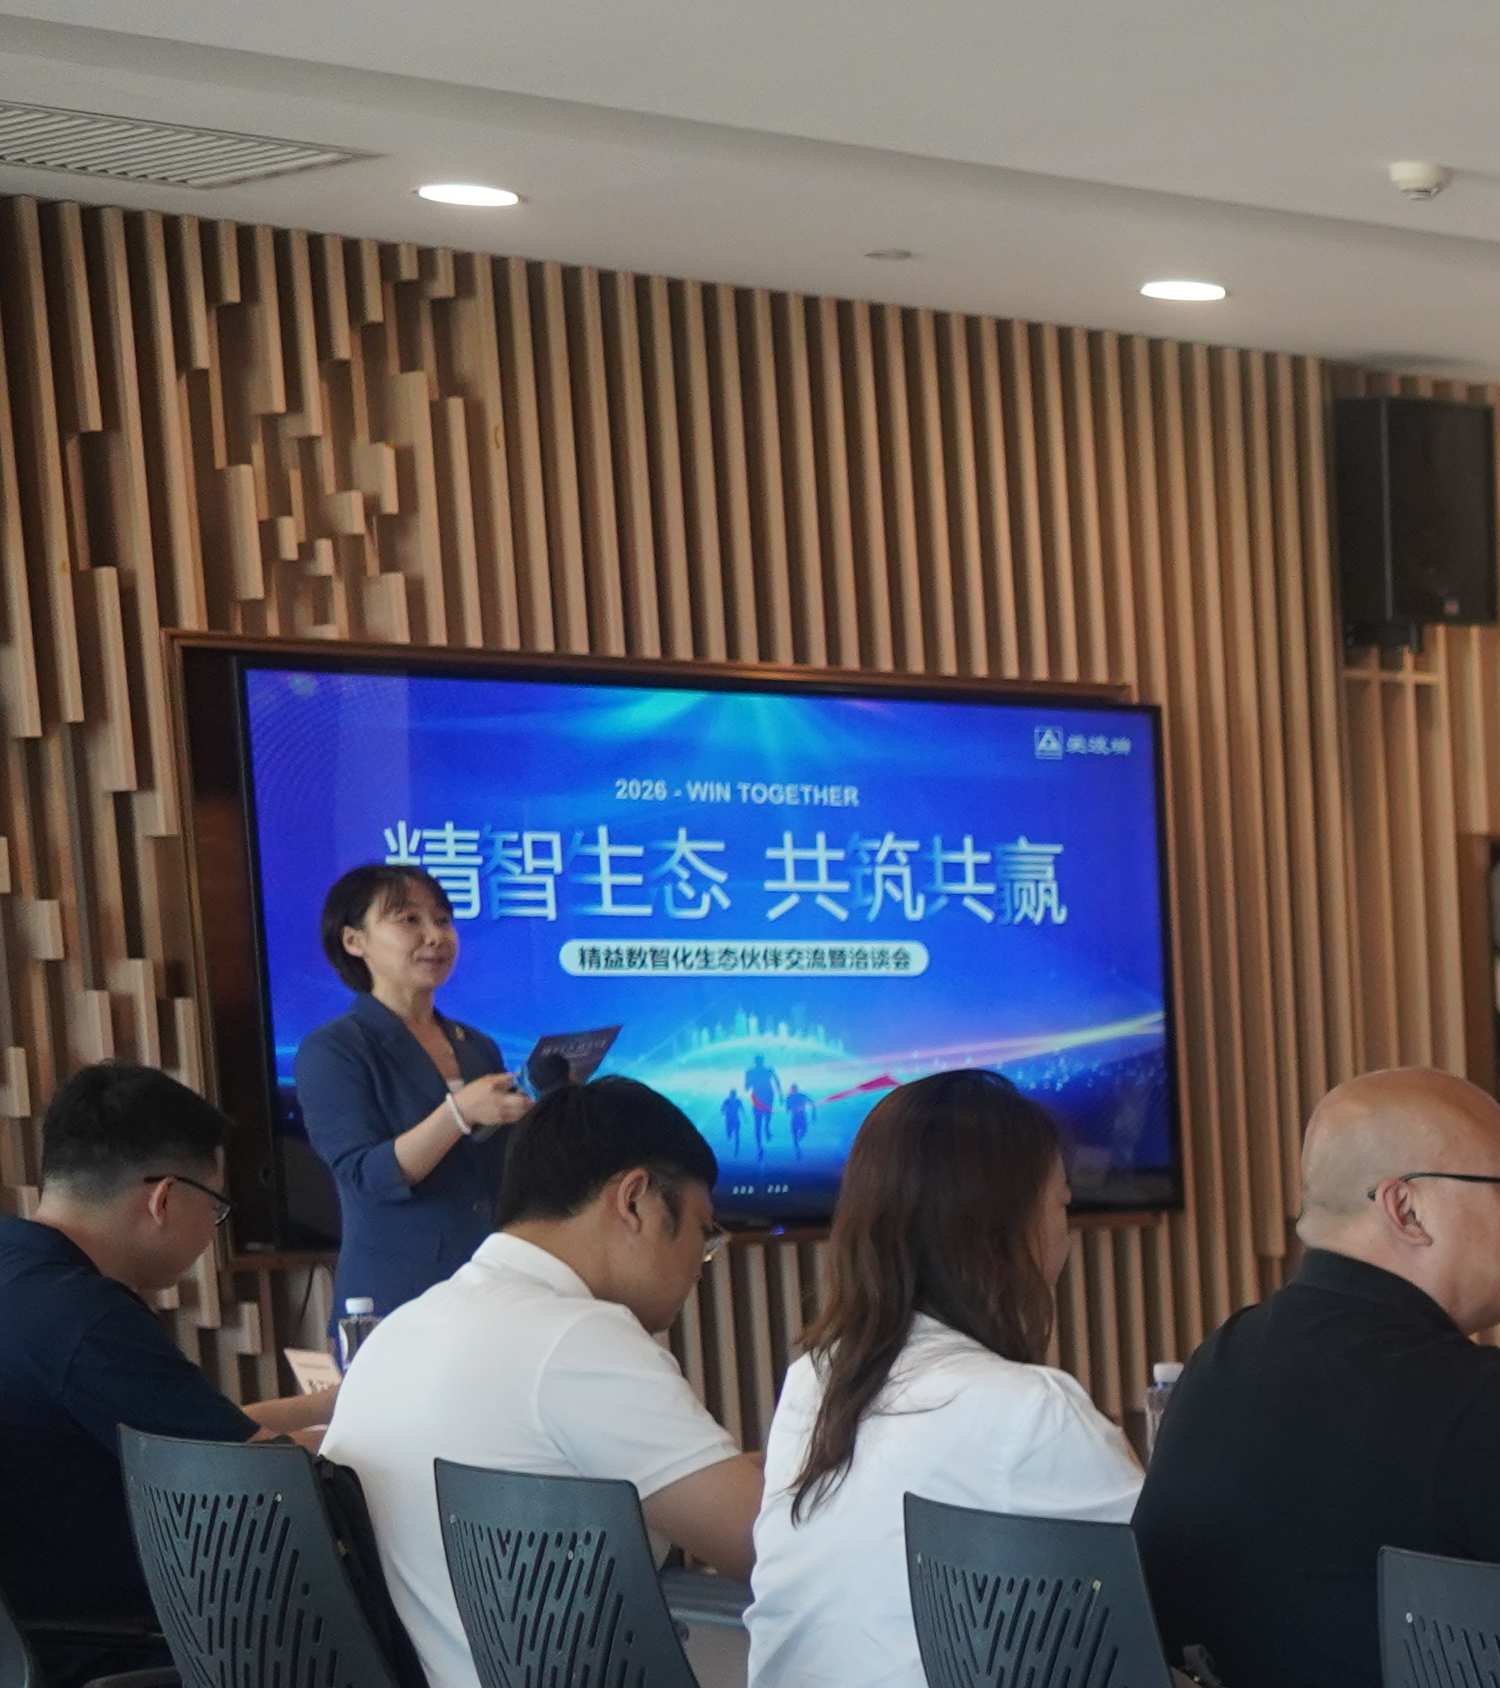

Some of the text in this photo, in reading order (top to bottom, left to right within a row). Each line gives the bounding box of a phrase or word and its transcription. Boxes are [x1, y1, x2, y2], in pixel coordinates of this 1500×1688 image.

[614, 777, 668, 803] 2026
[687, 781, 731, 806] WIN
[738, 783, 860, 808] TOGETHER
[385, 820, 1068, 926] 精智生态 共筑共赢
